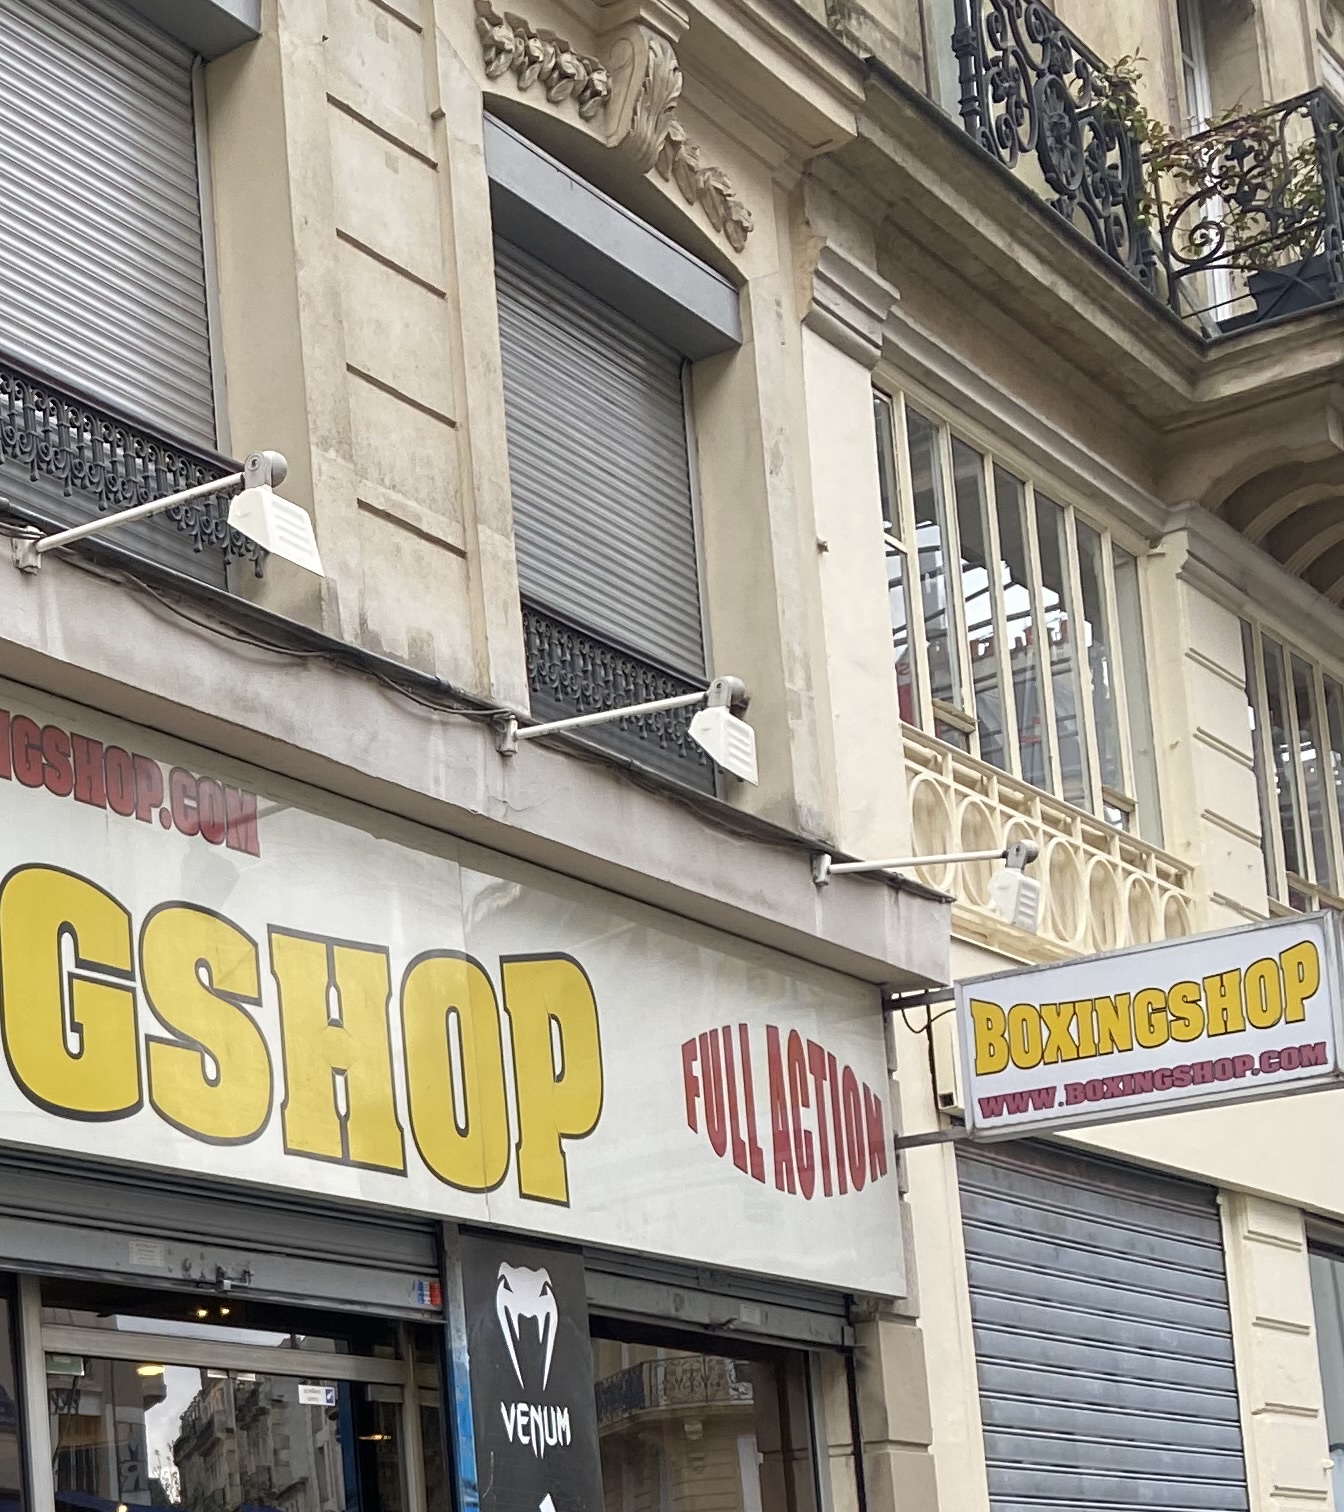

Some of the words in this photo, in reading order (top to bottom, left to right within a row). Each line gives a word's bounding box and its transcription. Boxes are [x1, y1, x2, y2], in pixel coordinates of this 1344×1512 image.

[969, 940, 1321, 1077] BOXINGSHOP
[681, 1022, 765, 1183] FULL
[766, 1024, 888, 1201] ACTION
[977, 1040, 1328, 1121] WWW.BOXINGSHOP.COM
[500, 1401, 572, 1459] VENUM
